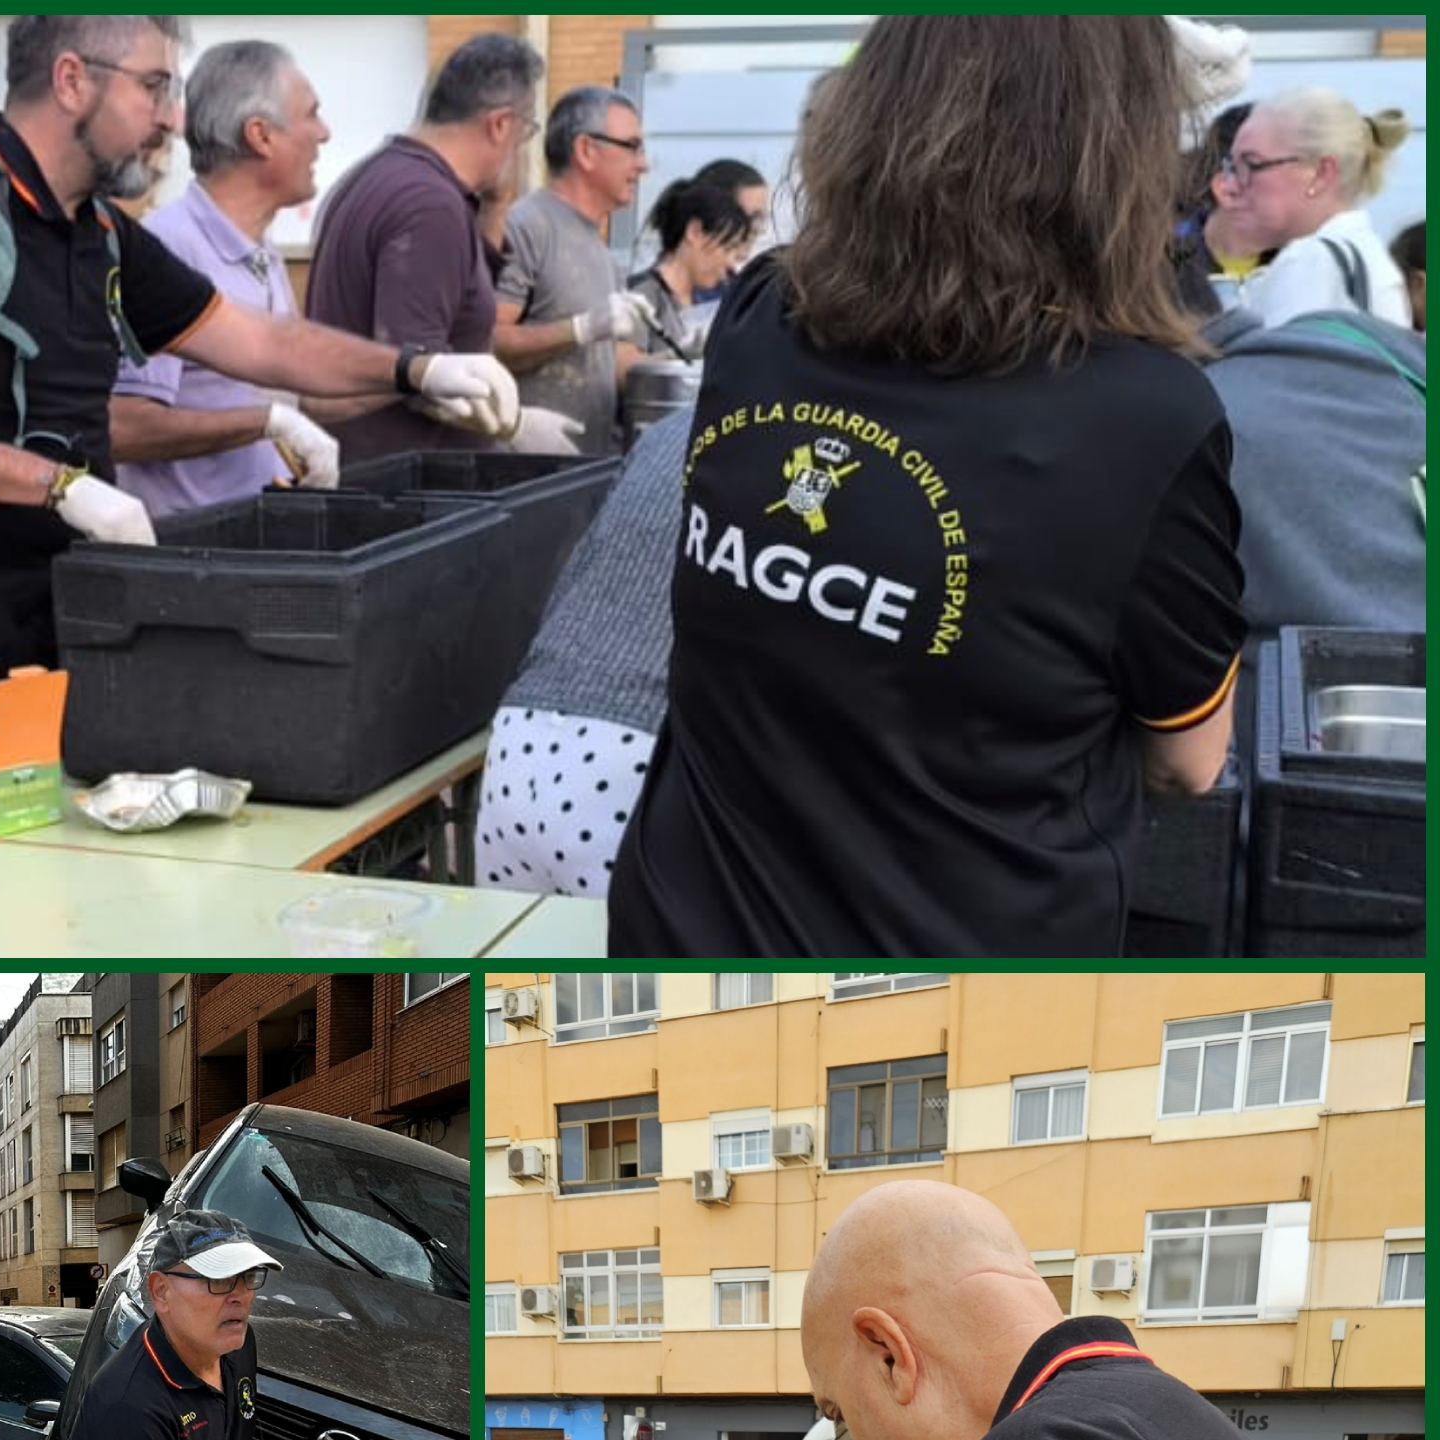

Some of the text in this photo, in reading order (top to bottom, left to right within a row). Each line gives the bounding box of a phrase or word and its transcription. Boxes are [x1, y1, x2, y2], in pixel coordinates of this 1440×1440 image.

[721, 408, 749, 434] DE
[754, 402, 785, 424] LA
[793, 402, 900, 458] GUARDIA
[900, 449, 949, 510] CIVIL
[937, 509, 967, 547] DE
[684, 503, 918, 644] RAGCE
[926, 553, 969, 656] ESPAÑA
[1229, 1408, 1269, 1431] iles
